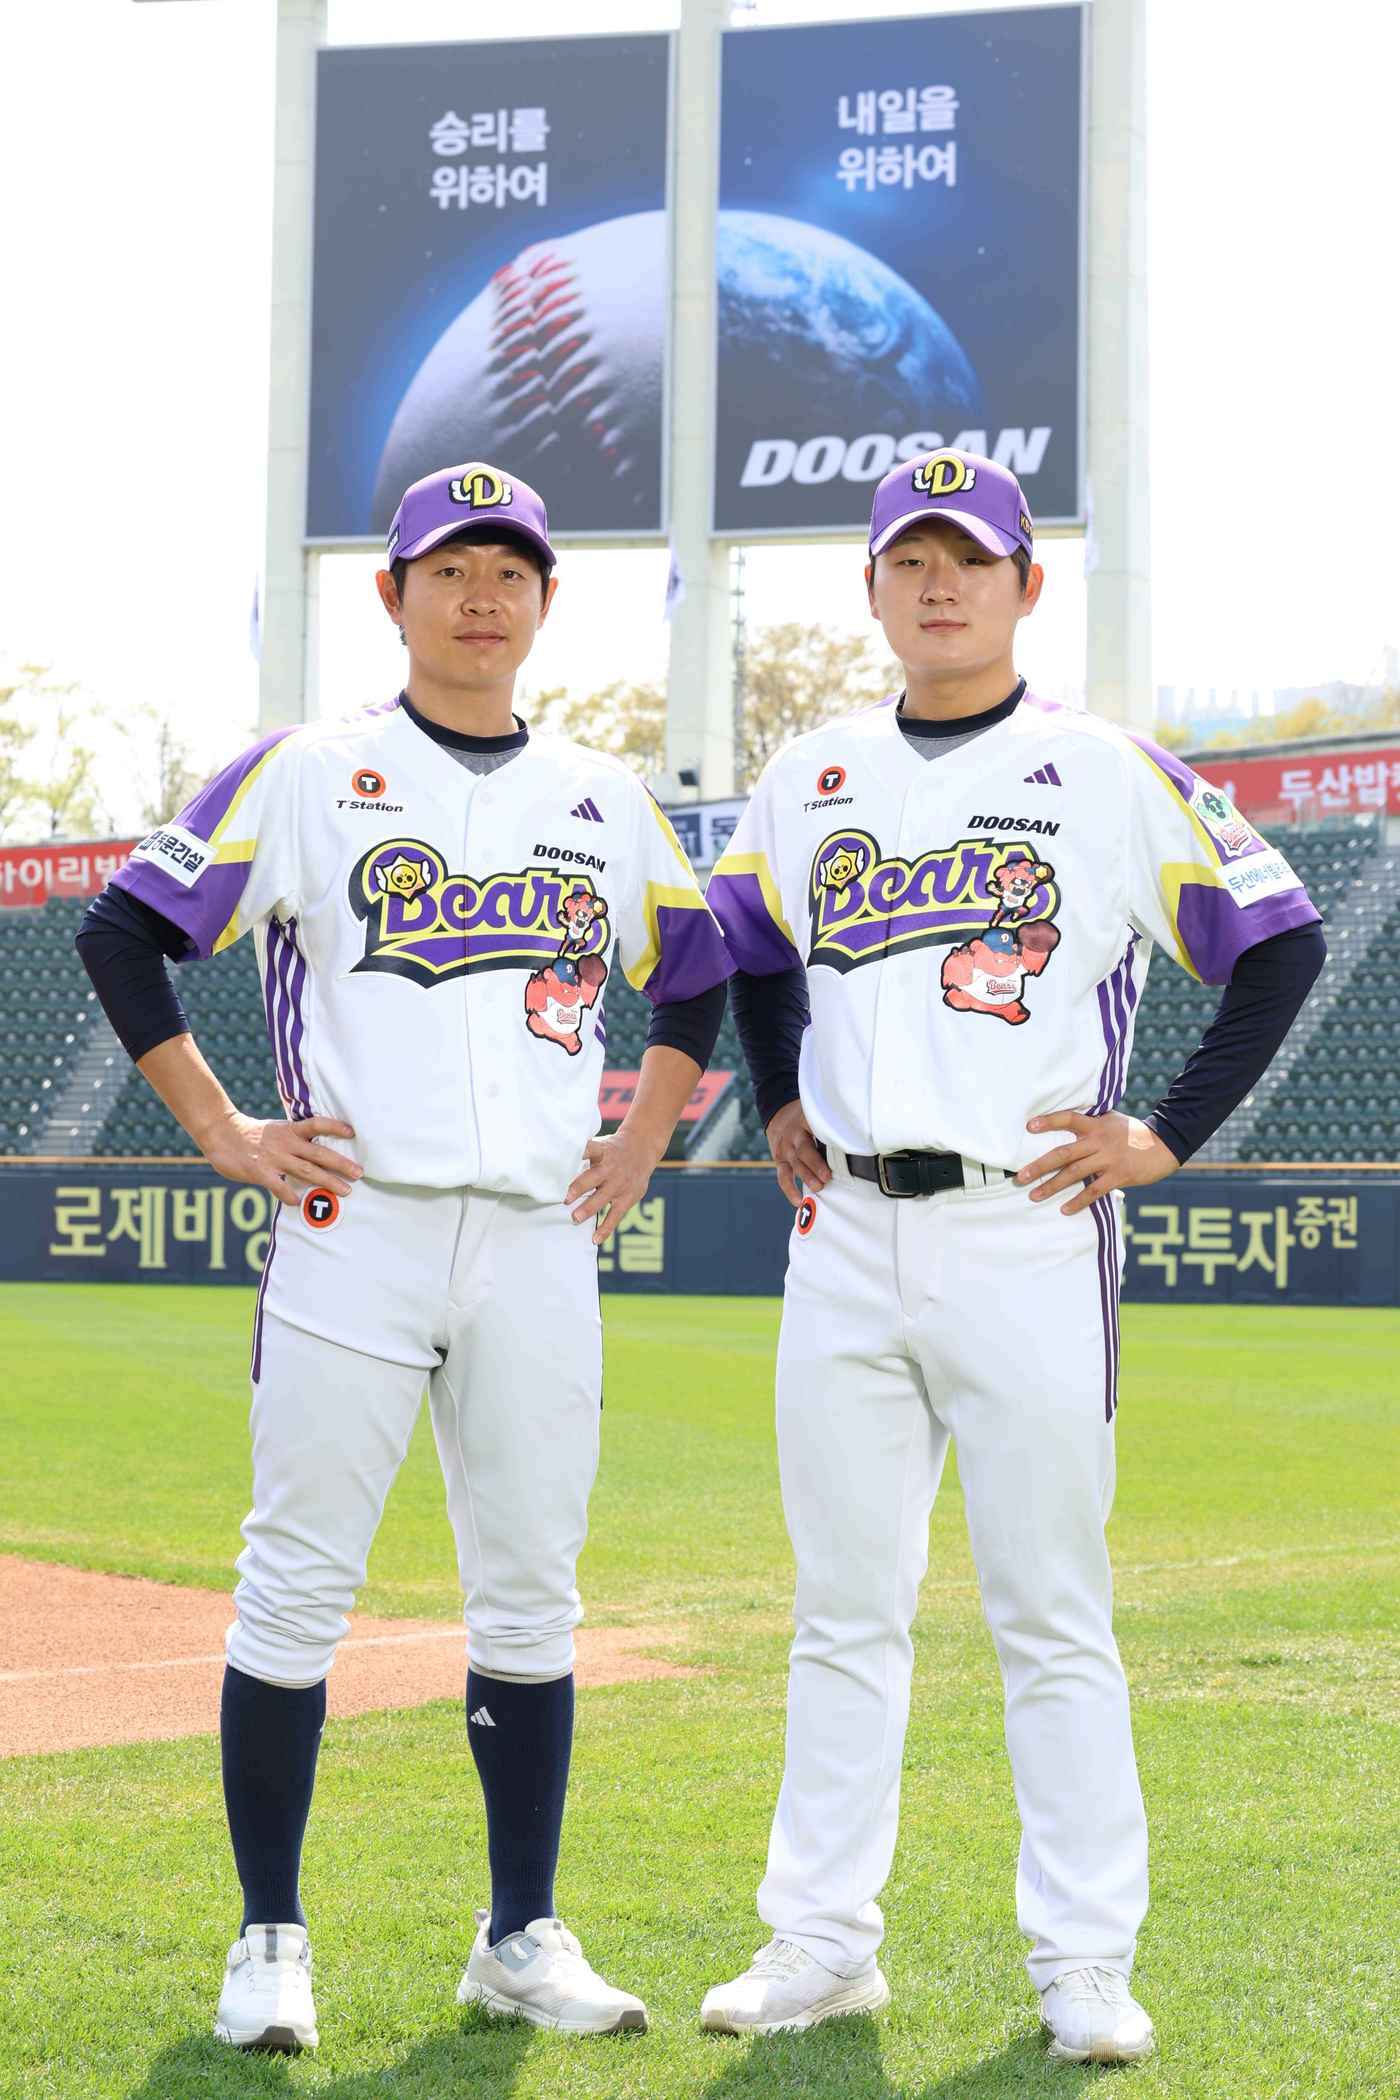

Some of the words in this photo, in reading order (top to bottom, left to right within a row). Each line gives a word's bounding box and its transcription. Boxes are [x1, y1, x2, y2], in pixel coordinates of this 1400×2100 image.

[430, 107, 551, 156] 승리를
[838, 85, 959, 135] 내일을
[430, 161, 547, 209] 위하여
[836, 141, 957, 192] 위하여
[967, 815, 1060, 836] DOOSAN
[533, 844, 606, 873] DOOSAN
